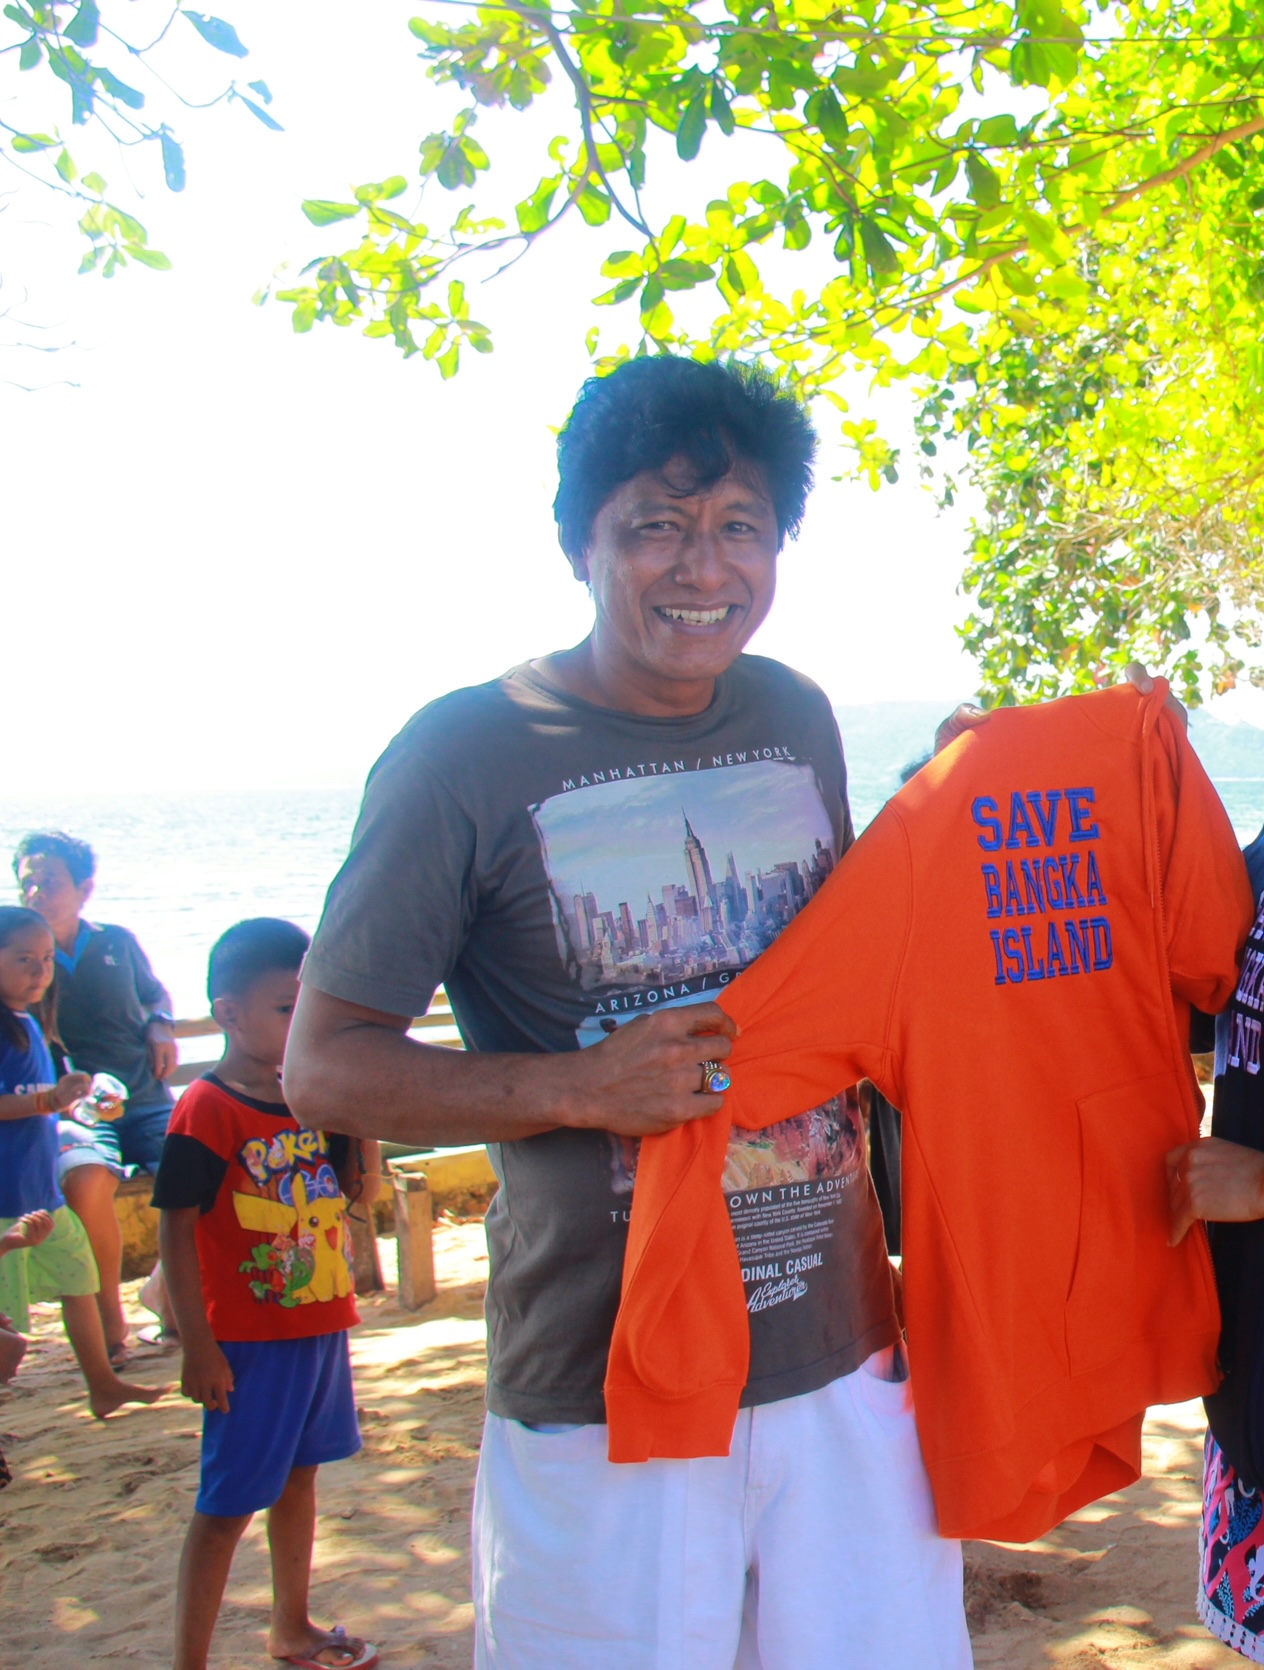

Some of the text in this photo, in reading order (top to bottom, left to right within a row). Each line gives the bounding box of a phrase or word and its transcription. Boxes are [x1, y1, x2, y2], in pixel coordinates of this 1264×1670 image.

[562, 760, 686, 791] MANHATTAN
[712, 751, 748, 767] NEW
[752, 746, 791, 761] YORK
[971, 787, 1101, 851] SAVE
[981, 850, 1109, 918] BANGKA
[989, 915, 1114, 986] ISLAND
[595, 983, 690, 1014] ARIZONA
[730, 1190, 773, 1208] OWN
[780, 1184, 811, 1200] THE
[610, 1210, 631, 1223] TU
[741, 1252, 824, 1283] DINAL CASUAL
